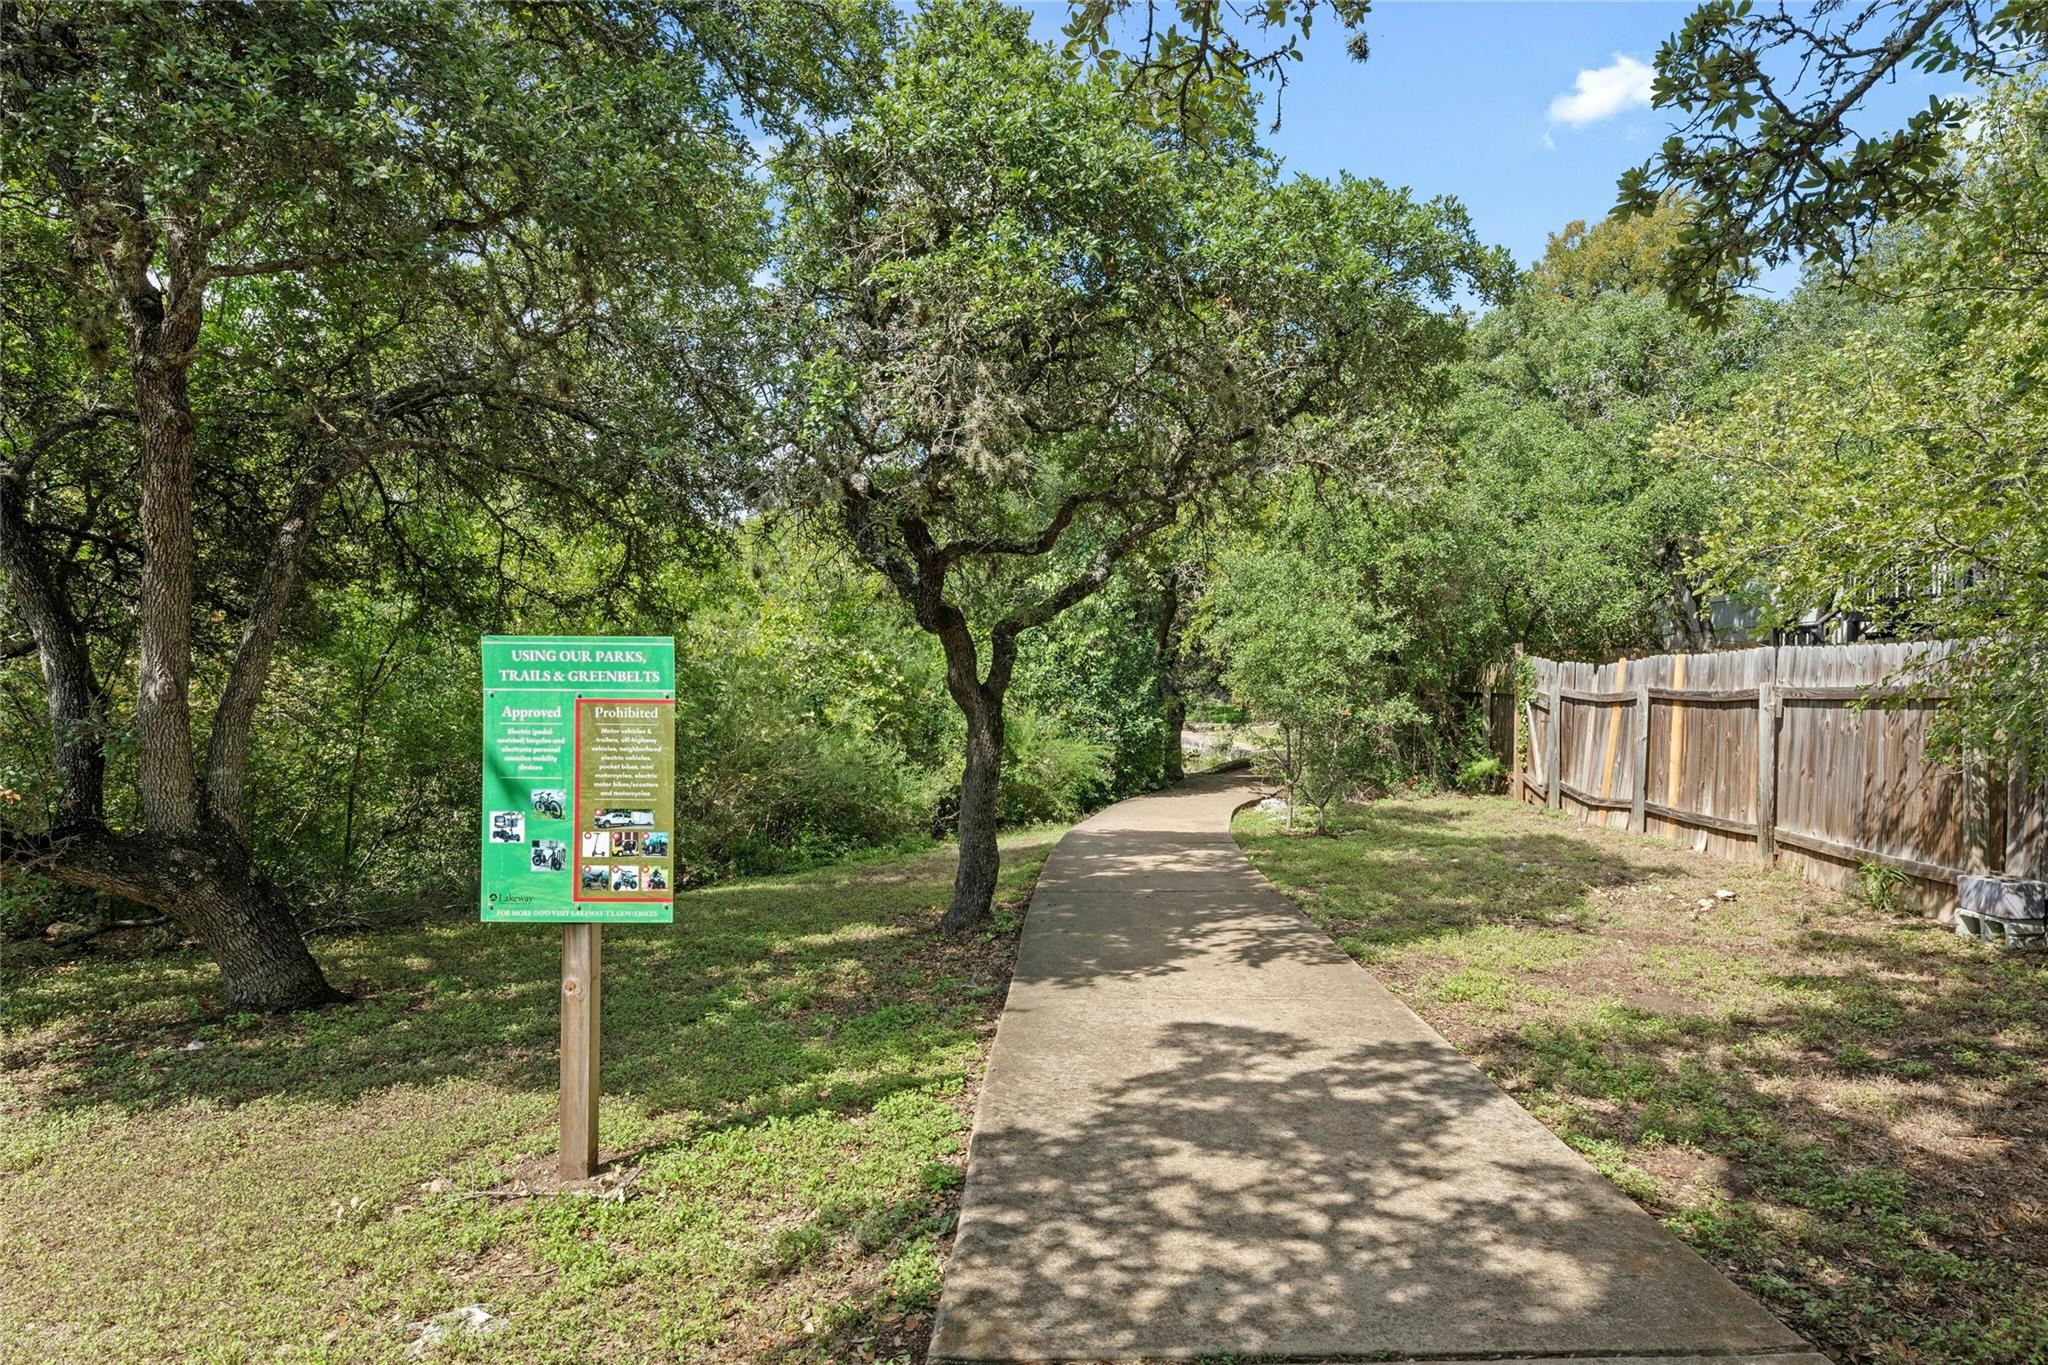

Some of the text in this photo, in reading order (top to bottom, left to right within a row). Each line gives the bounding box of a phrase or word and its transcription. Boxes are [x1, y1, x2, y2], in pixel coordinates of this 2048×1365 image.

[511, 650, 646, 664] USING OUR PARKS,
[498, 669, 660, 683] TRAILS & GREENBELTS
[502, 705, 561, 721] Approved
[595, 706, 658, 718] Prohibited
[526, 737, 551, 745] bicycles
[533, 746, 560, 754] personal
[533, 755, 557, 763] mobility
[499, 893, 534, 903] Lakeway
[497, 909, 511, 917] FOR
[512, 909, 532, 917] MORE
[533, 909, 551, 917] INFO
[552, 909, 570, 917] VISIT
